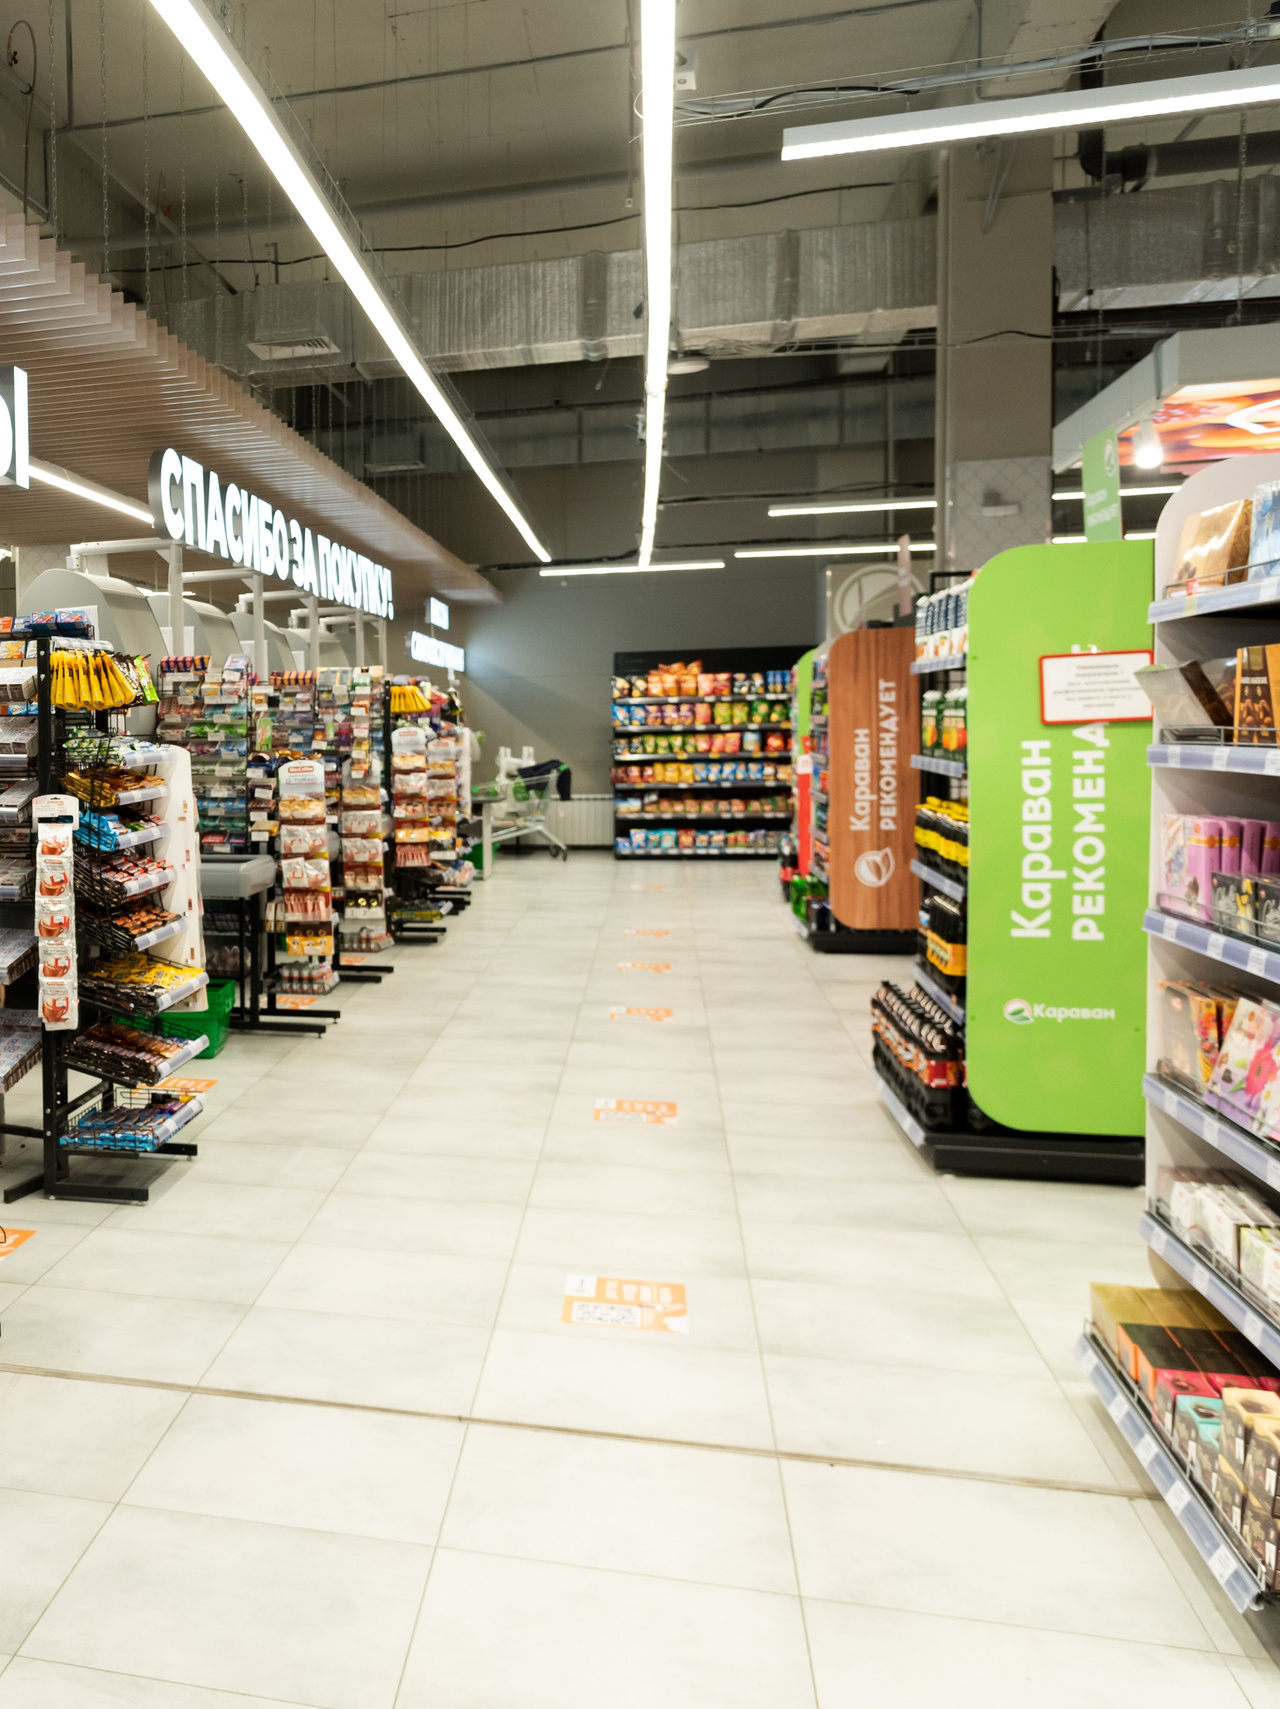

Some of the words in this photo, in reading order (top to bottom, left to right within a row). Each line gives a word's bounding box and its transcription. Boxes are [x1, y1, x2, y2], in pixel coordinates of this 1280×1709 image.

[160, 448, 289, 580] СПАСИБО
[291, 518, 319, 597] ЗА
[318, 534, 394, 621] ПОКУПКУ!
[848, 728, 877, 831] Караван
[879, 678, 898, 831] РЕКОМЕНДУЕТ
[1071, 645, 1111, 940] РЕКОМЕНД
[1010, 740, 1067, 938] Караван
[1032, 1003, 1115, 1023] Караван
